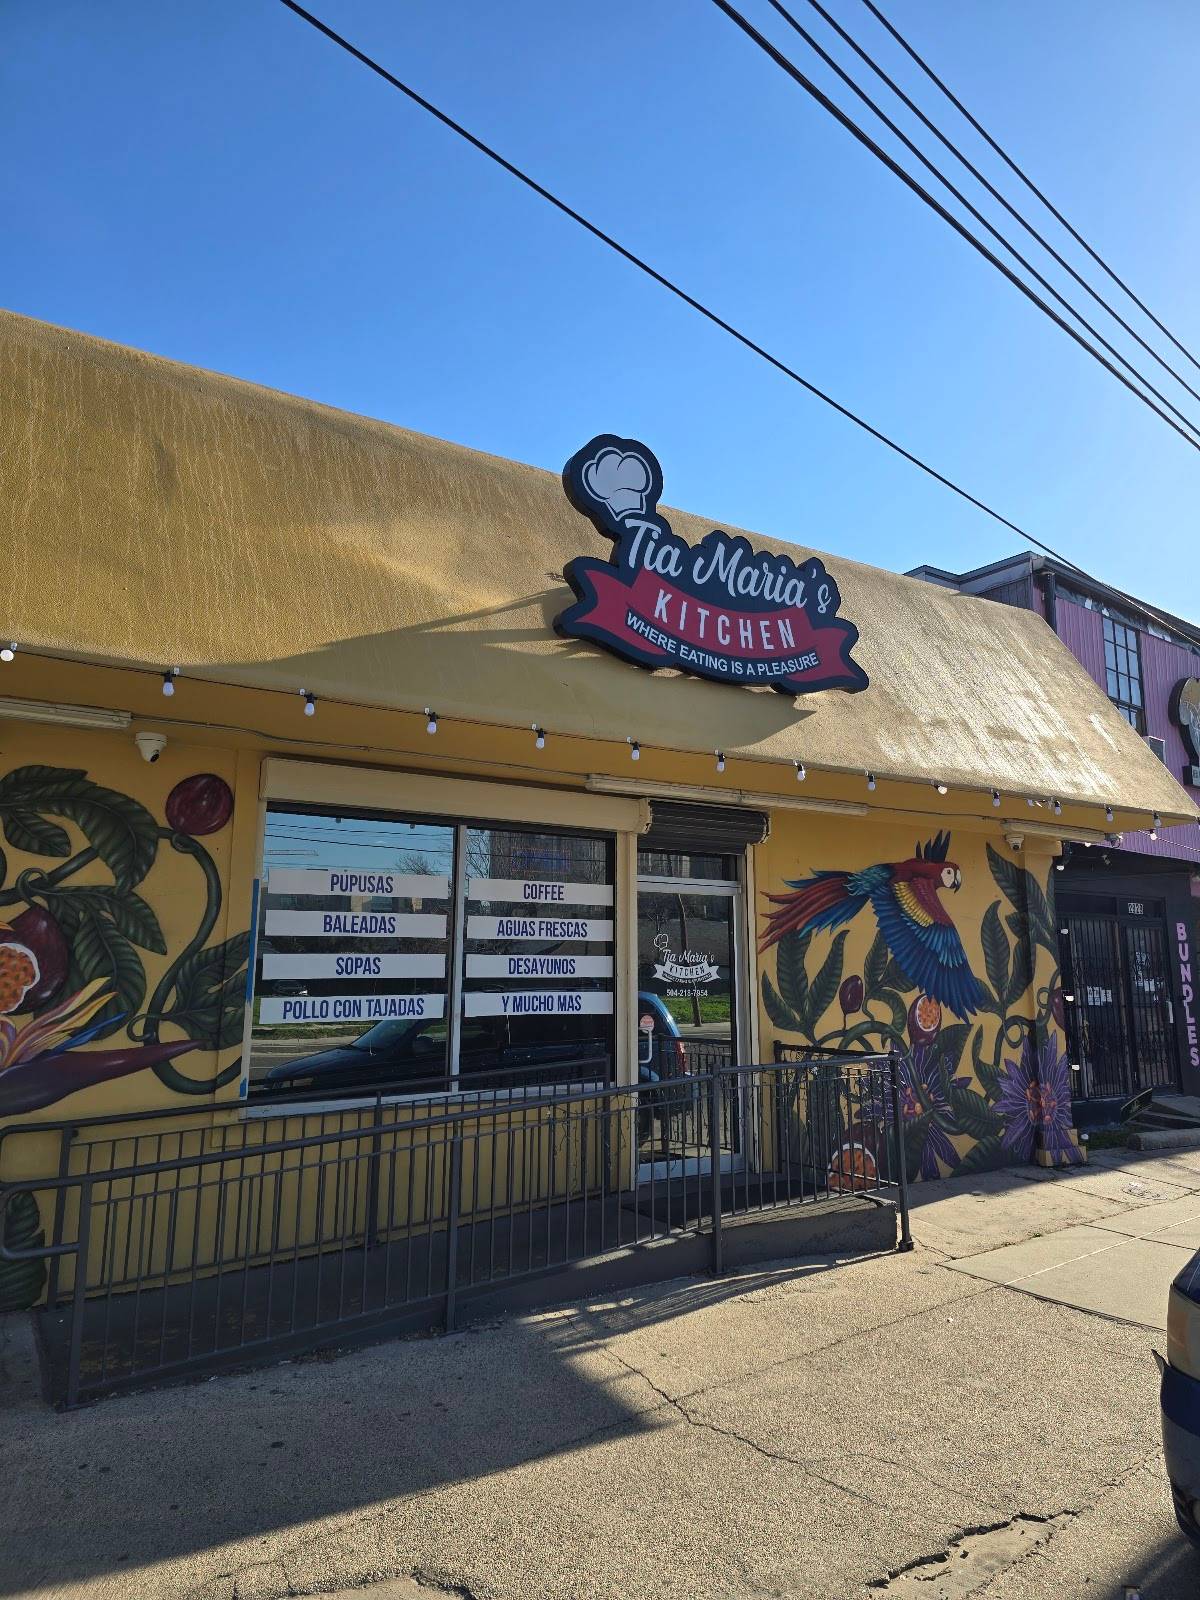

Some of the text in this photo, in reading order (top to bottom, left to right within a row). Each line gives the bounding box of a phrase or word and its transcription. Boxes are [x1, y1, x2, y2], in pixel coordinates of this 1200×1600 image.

[625, 518, 832, 614] Tia Maria's
[654, 589, 795, 649] KITCHEN
[627, 612, 819, 676] WHERE EATING IS A PLEASURE
[330, 873, 394, 894] PUPUSAS
[523, 884, 564, 901] COFFEE
[323, 914, 396, 934] BALEADAS
[497, 919, 587, 938] AGUAS FRESCAS
[335, 957, 381, 976] SOPAS
[508, 957, 576, 976] DESAYUNOS
[670, 964, 704, 977] KITCHEN
[502, 995, 582, 1013] Y MUCHO MAS
[1176, 922, 1200, 1066] BUNDLES
[283, 997, 425, 1020] POLLO CON TAJADAS
